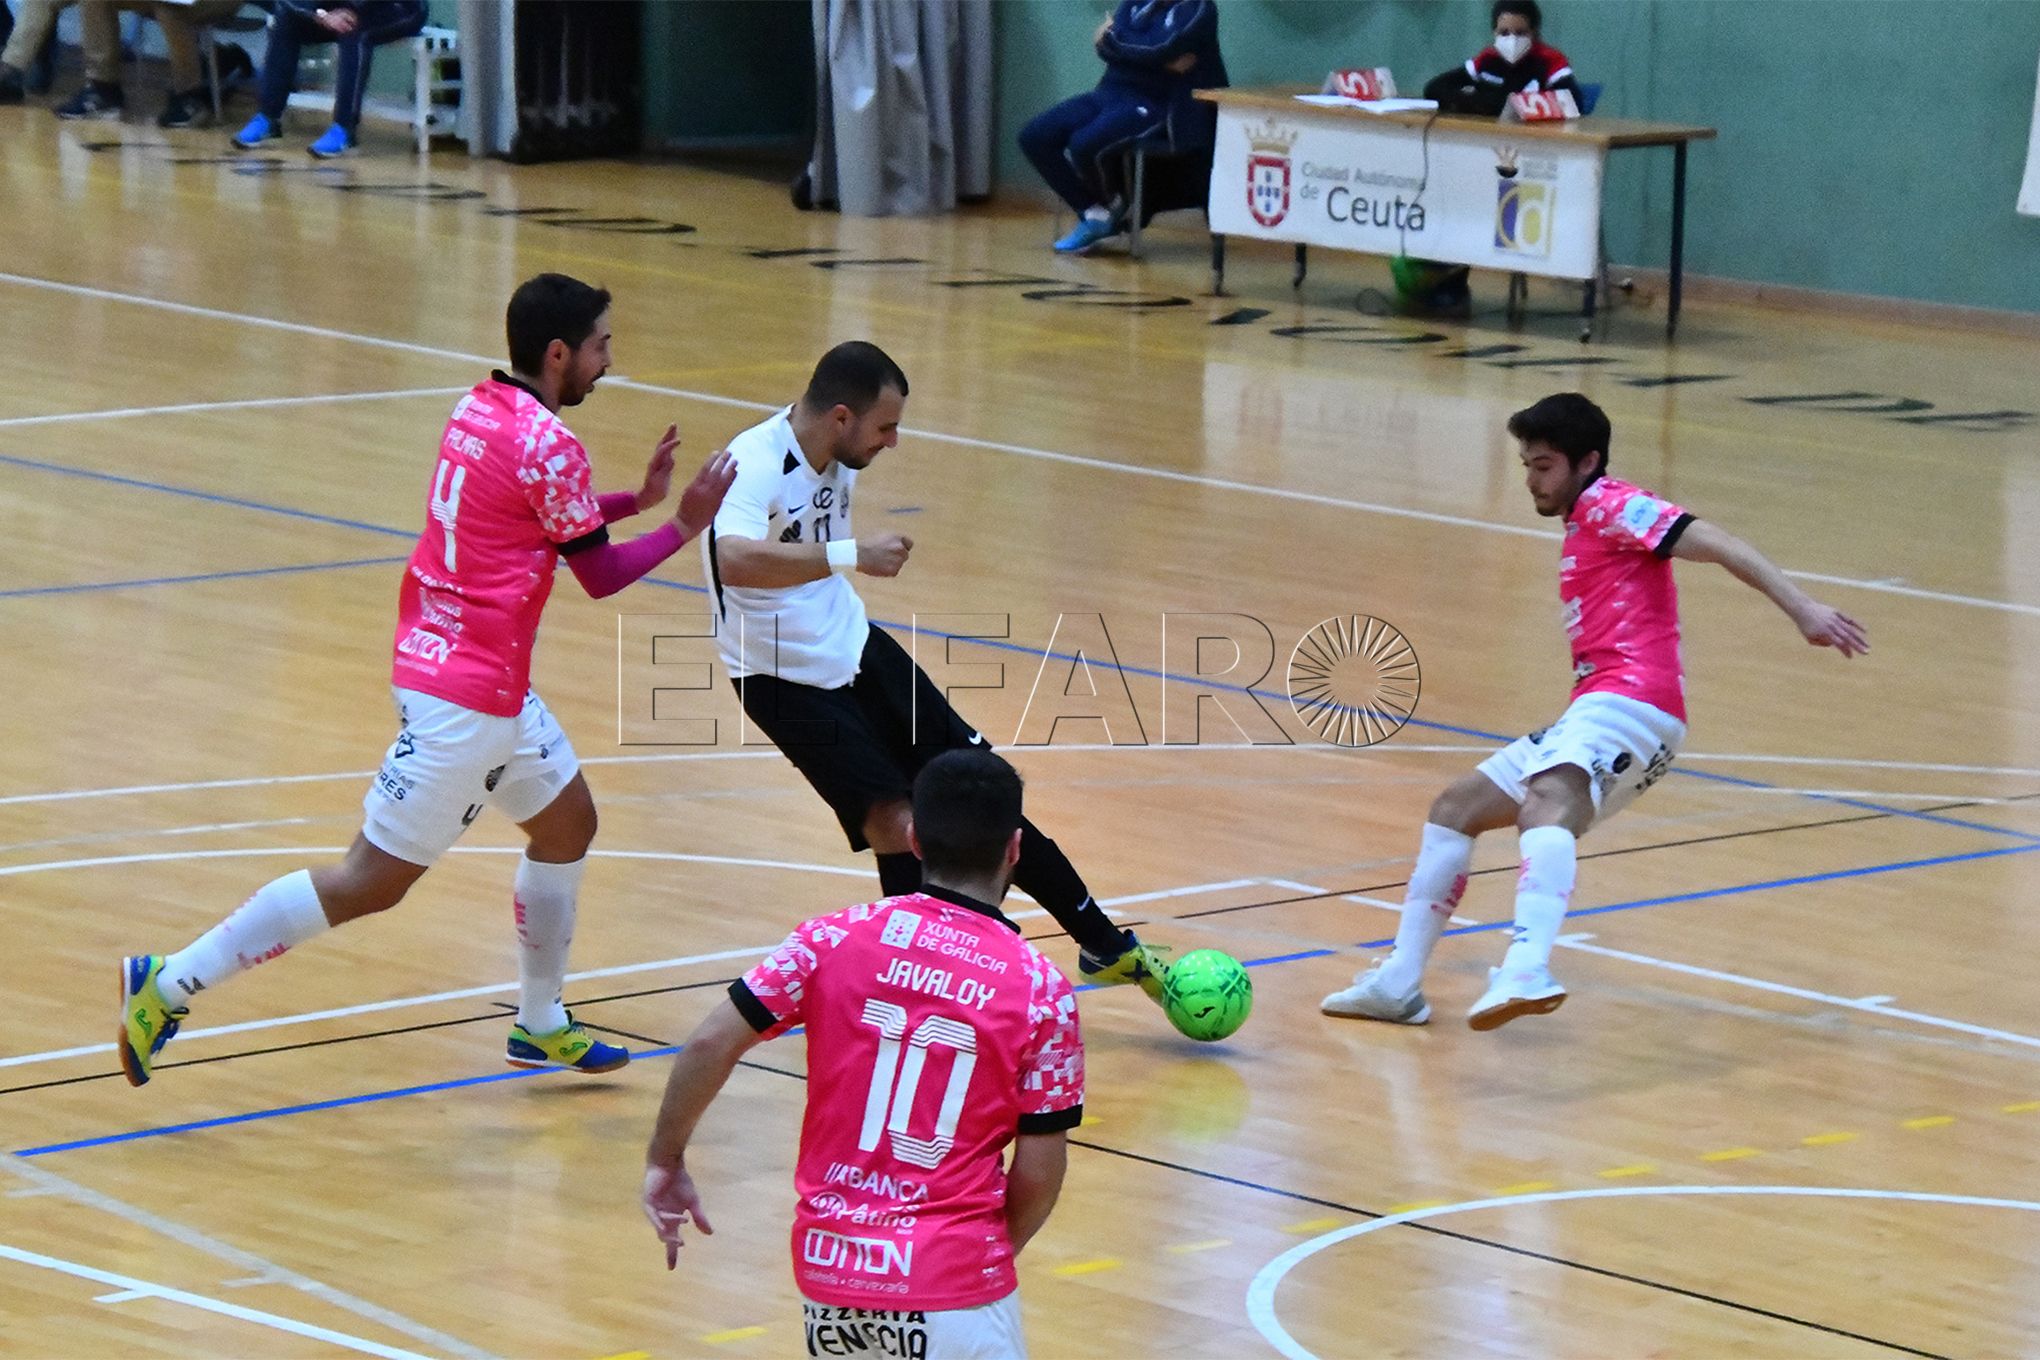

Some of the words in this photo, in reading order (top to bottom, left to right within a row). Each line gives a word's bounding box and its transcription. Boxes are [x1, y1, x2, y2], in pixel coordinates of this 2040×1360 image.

[1327, 186, 1425, 231] Ceuta
[431, 458, 466, 574] 4
[916, 935, 940, 951] DE
[940, 943, 1008, 974] GALICIA
[924, 921, 980, 948] XUNTA
[876, 957, 996, 1010] JAVALOY
[859, 998, 978, 1170] 10
